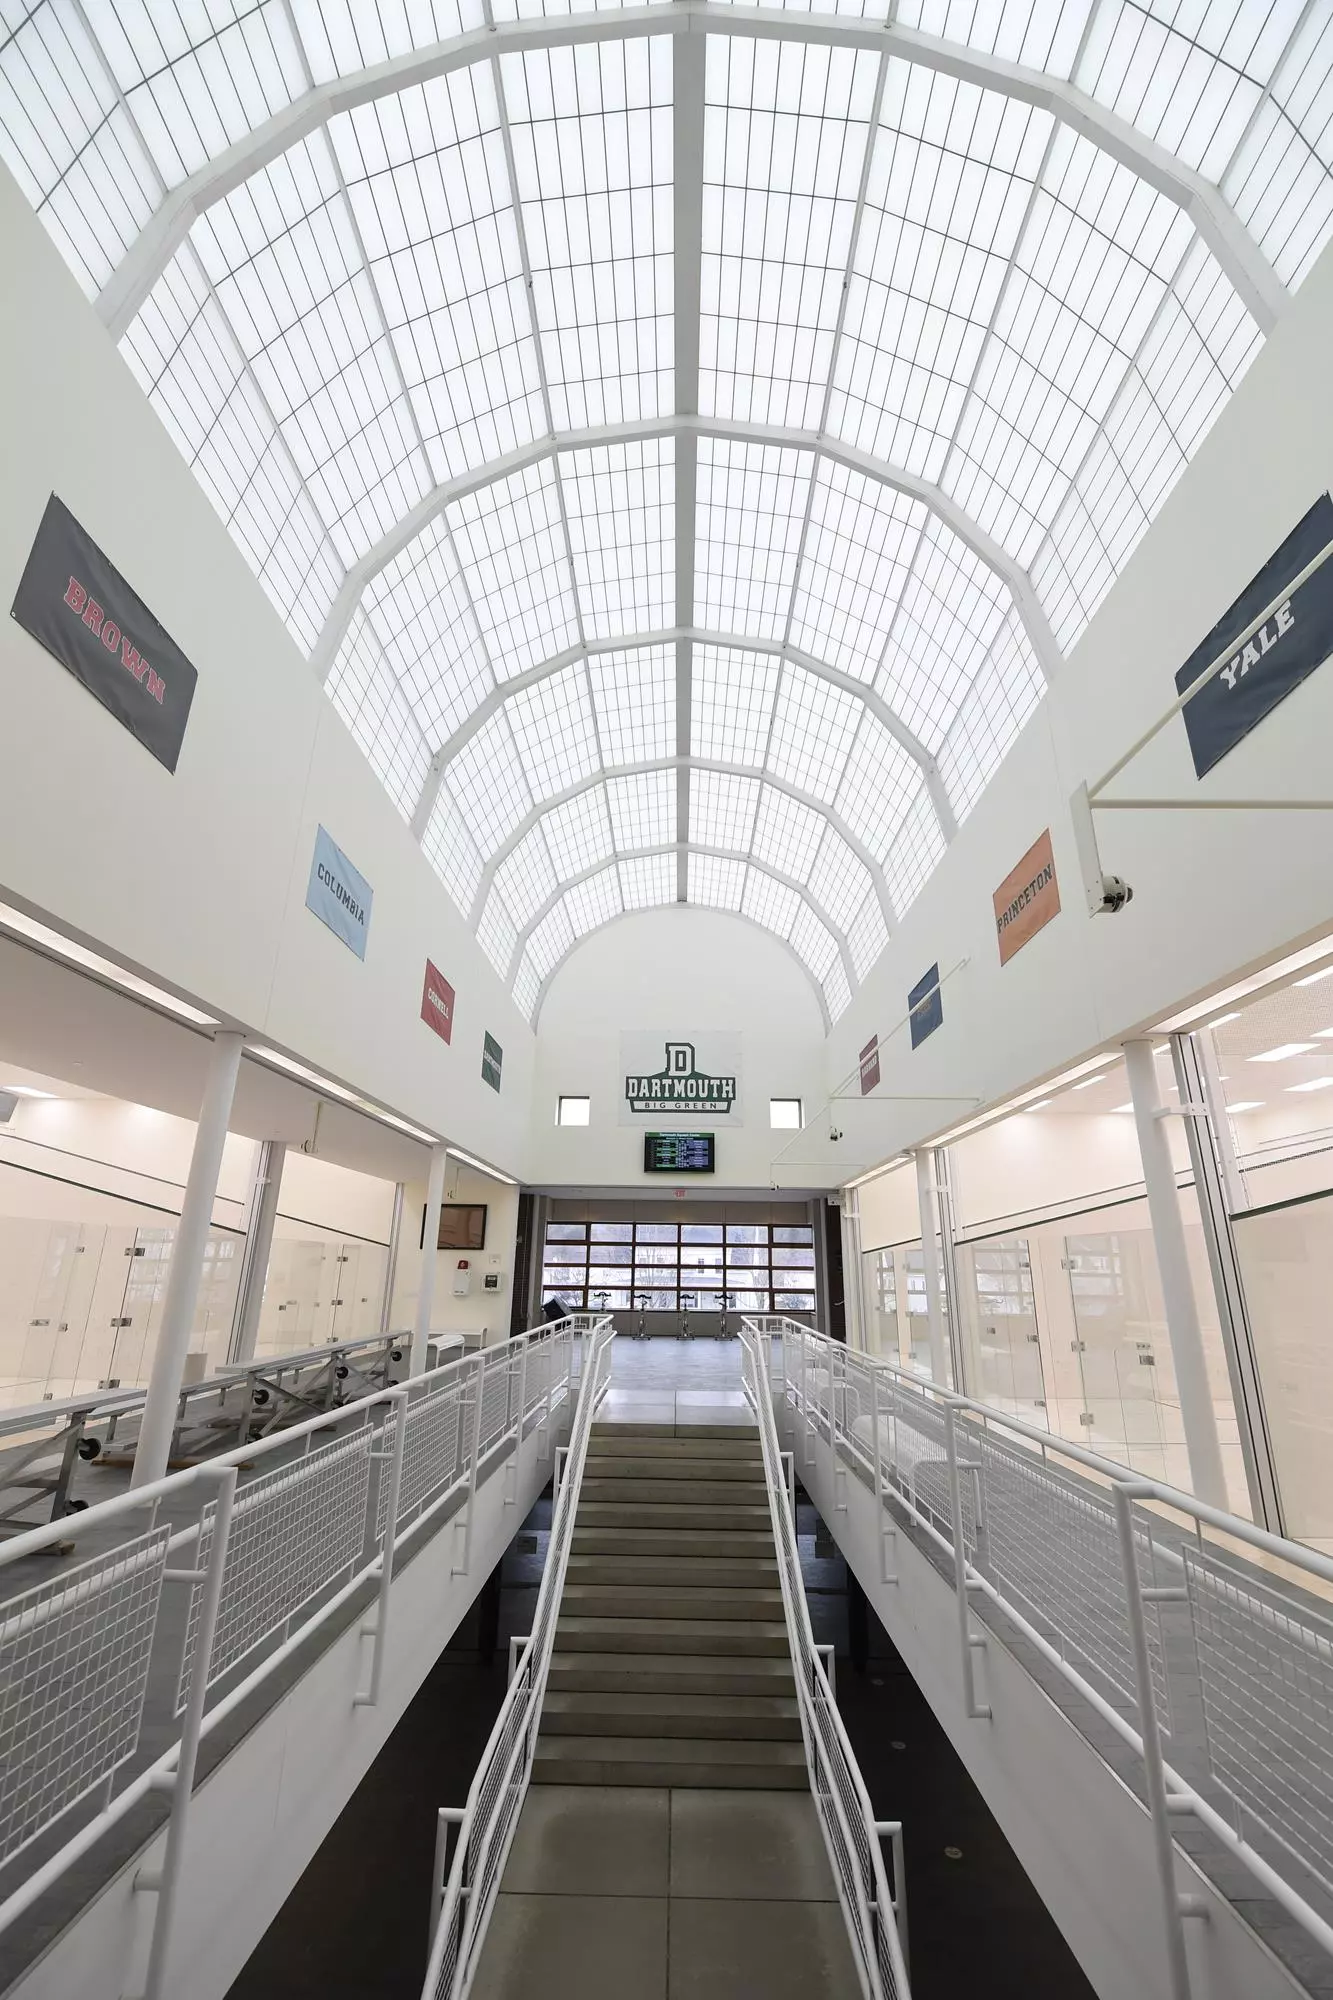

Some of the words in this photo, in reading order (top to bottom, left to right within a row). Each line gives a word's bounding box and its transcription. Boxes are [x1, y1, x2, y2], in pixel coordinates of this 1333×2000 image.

[63, 576, 167, 705] BROWN
[1219, 600, 1296, 690] YALE
[317, 862, 365, 926] COLUMBIA
[996, 863, 1054, 935] PRINCETON
[428, 987, 449, 1019] CORNELL
[627, 1078, 734, 1098] DARTMOUTH
[665, 1042, 696, 1077] D
